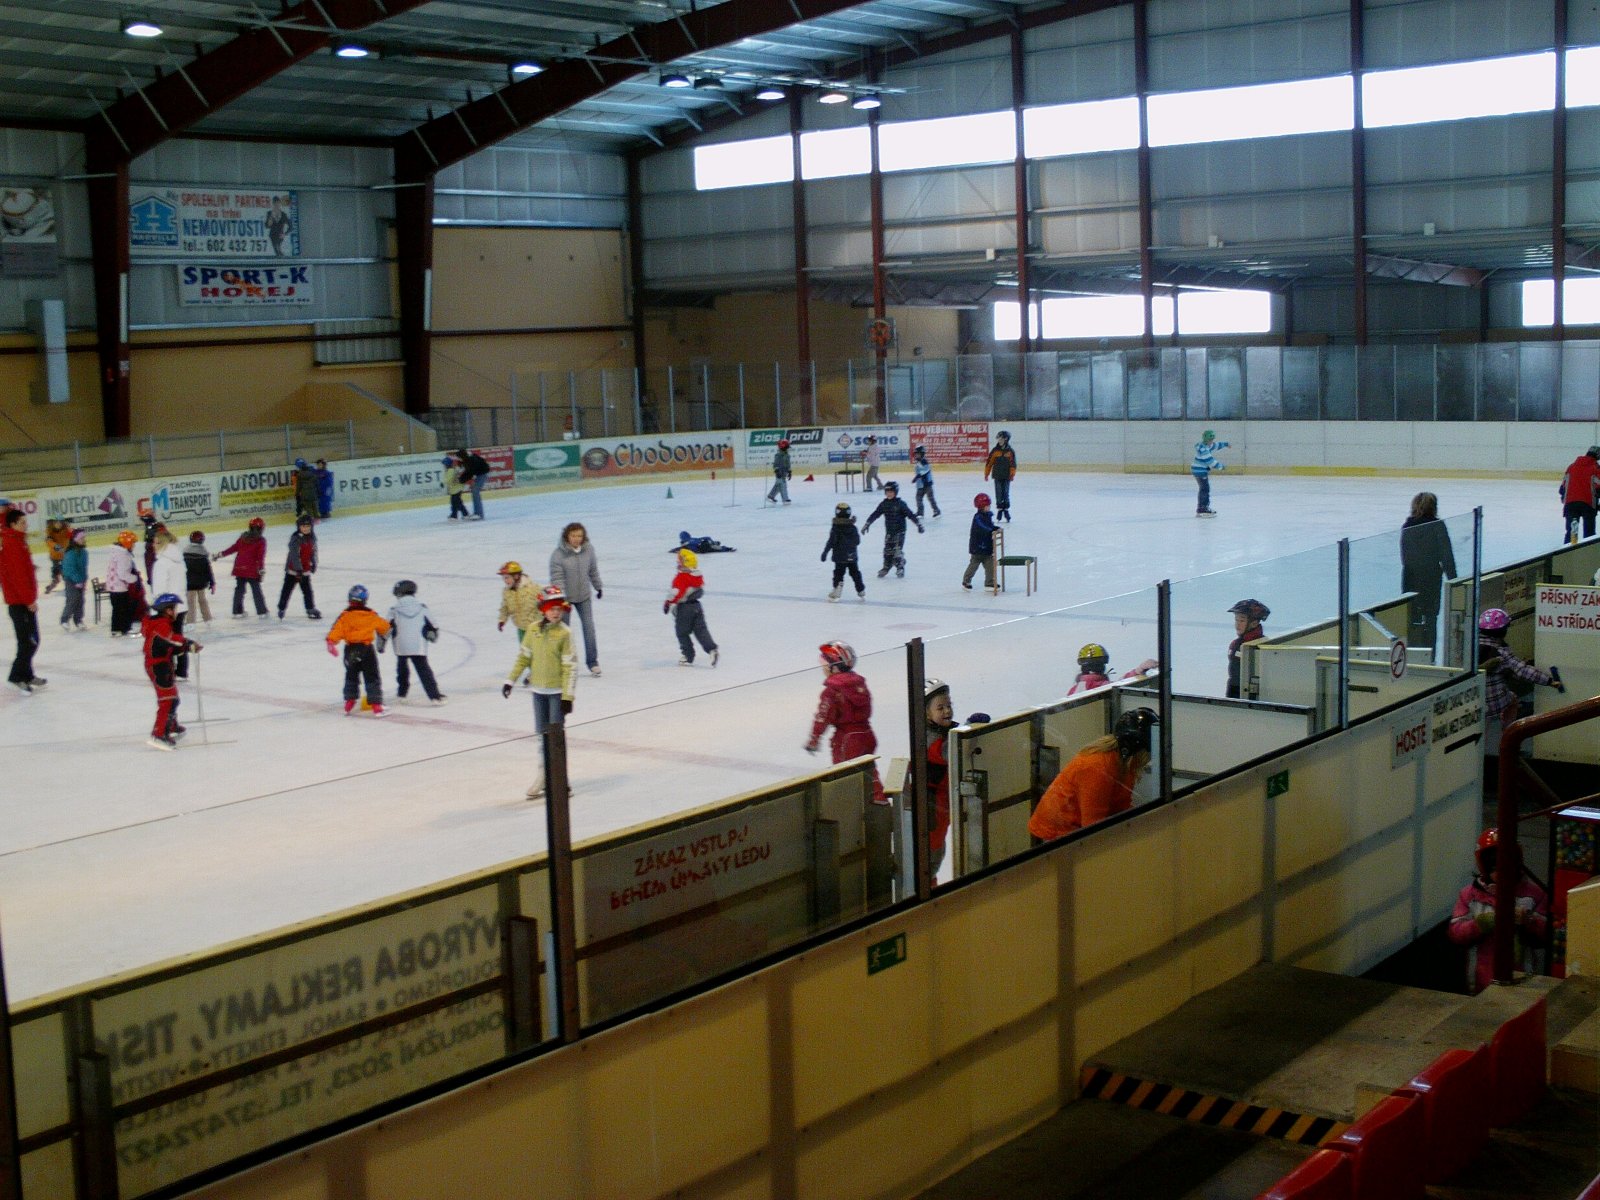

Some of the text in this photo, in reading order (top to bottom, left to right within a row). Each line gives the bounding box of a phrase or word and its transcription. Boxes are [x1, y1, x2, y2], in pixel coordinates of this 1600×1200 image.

[183, 218, 264, 237] NEMOVITOSTI
[183, 266, 309, 285] SPORT-K
[200, 287, 295, 298] HOKEJ
[789, 430, 820, 443] profi
[614, 440, 729, 467] Chodovar
[169, 480, 202, 490] TACHOV
[46, 496, 95, 515] INOTECH
[170, 493, 212, 509] TRANSPORT
[1540, 588, 1578, 605] PŘÍSNÝ
[1538, 615, 1553, 628] NA
[1395, 715, 1426, 757] HOSTÉ
[634, 846, 687, 877] ZÁKAZ
[734, 842, 771, 869] LEDU
